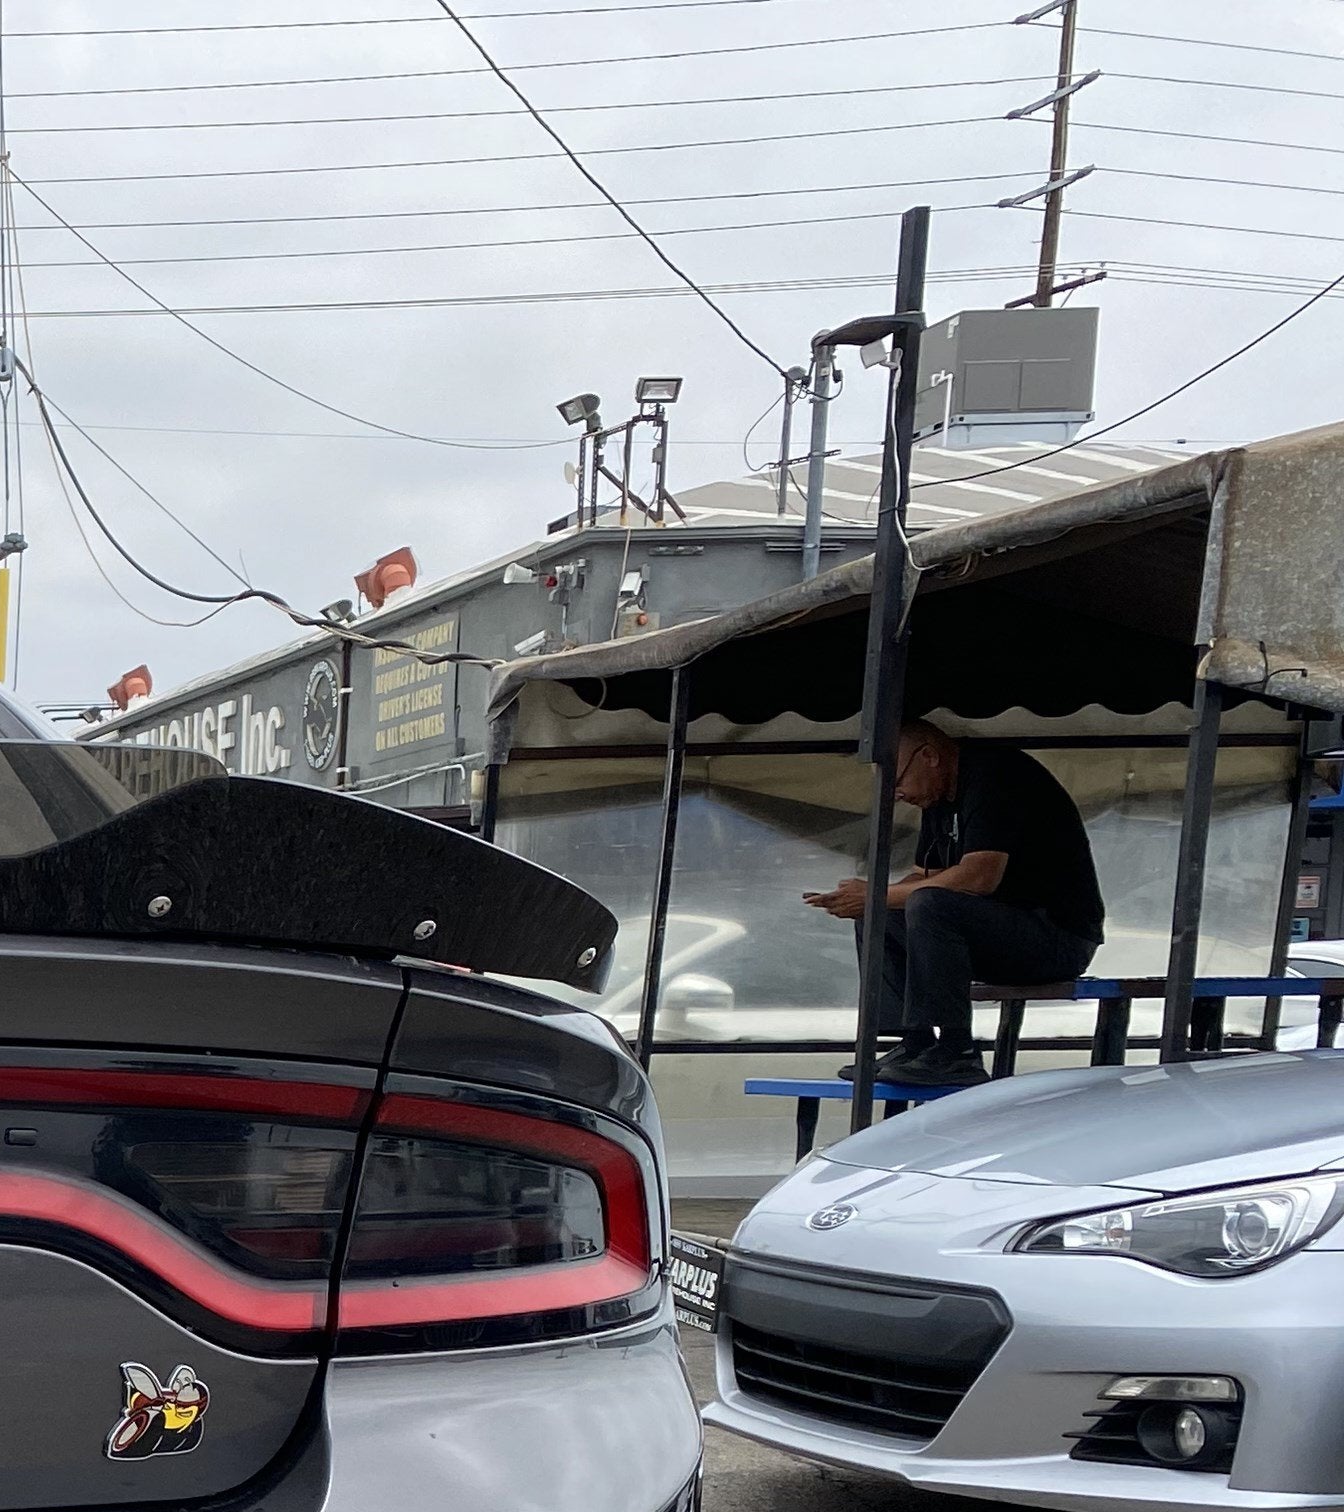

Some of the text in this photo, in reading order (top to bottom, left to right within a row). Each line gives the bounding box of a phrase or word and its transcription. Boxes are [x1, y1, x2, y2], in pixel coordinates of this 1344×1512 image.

[416, 620, 455, 651] COMPANY
[241, 693, 291, 776] Inc.
[399, 712, 445, 745] CUSTOMERS
